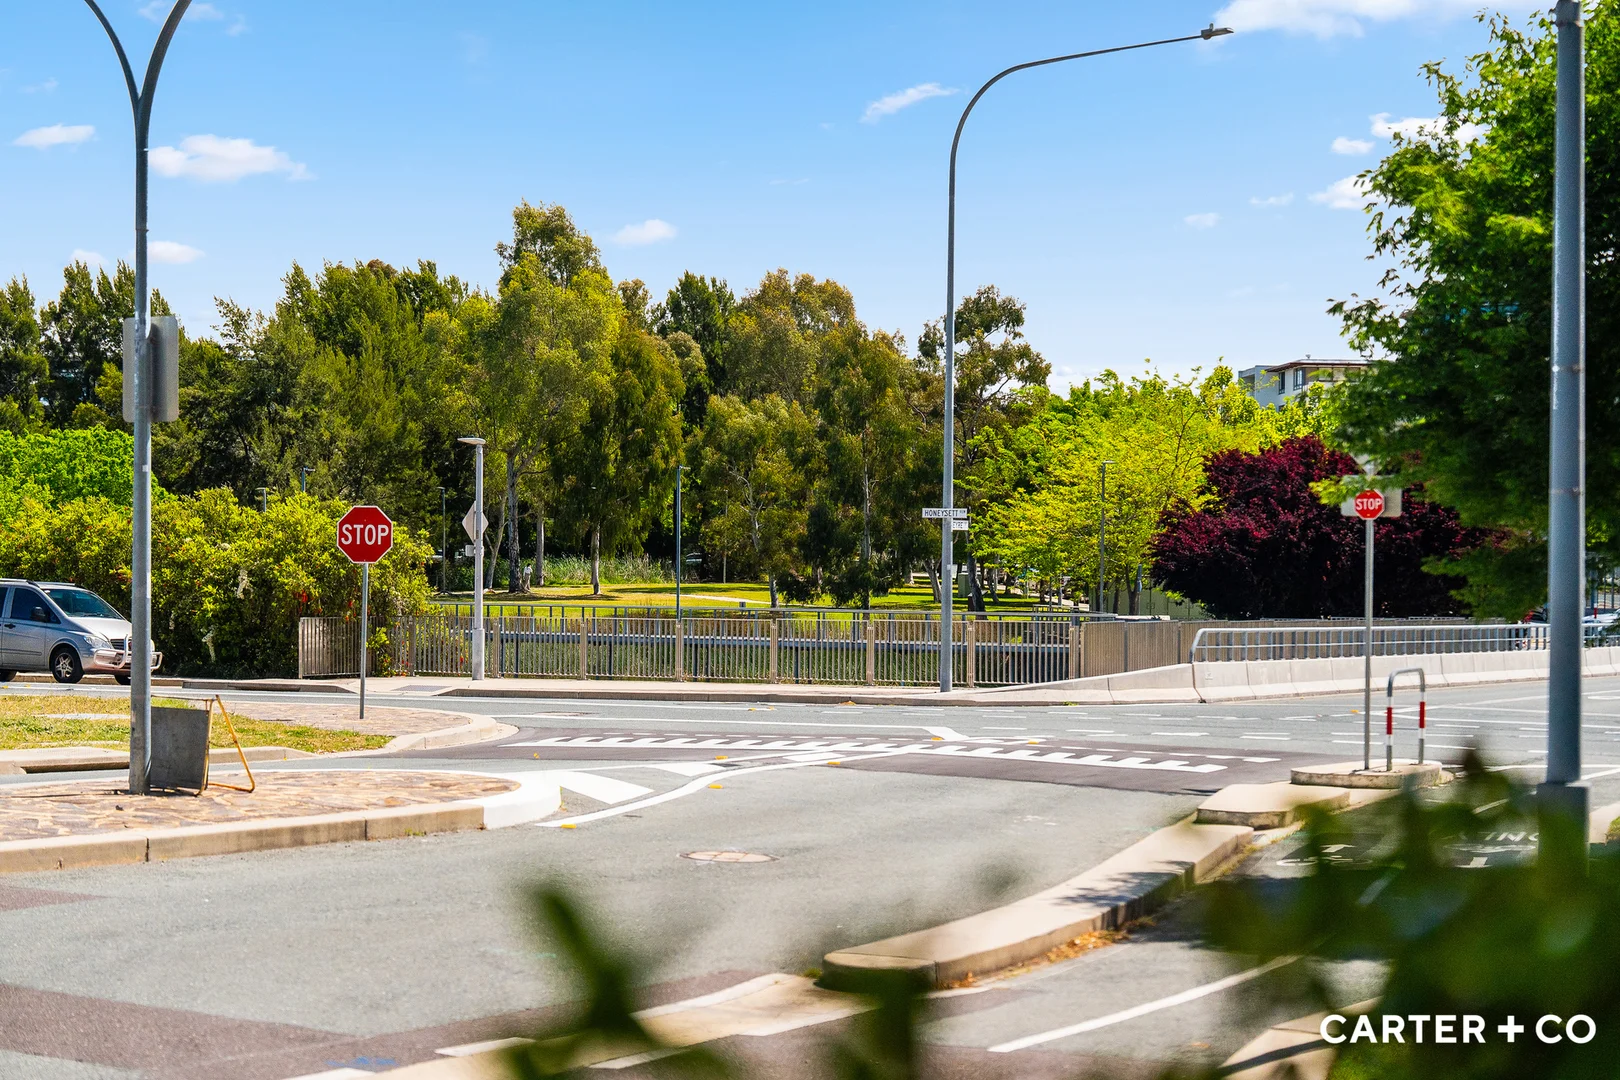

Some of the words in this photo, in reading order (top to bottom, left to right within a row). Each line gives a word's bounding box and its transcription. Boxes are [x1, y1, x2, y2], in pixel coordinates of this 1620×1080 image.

[1355, 498, 1383, 511] STOP
[924, 509, 958, 517] HONEYSETT
[340, 523, 389, 545] STOP
